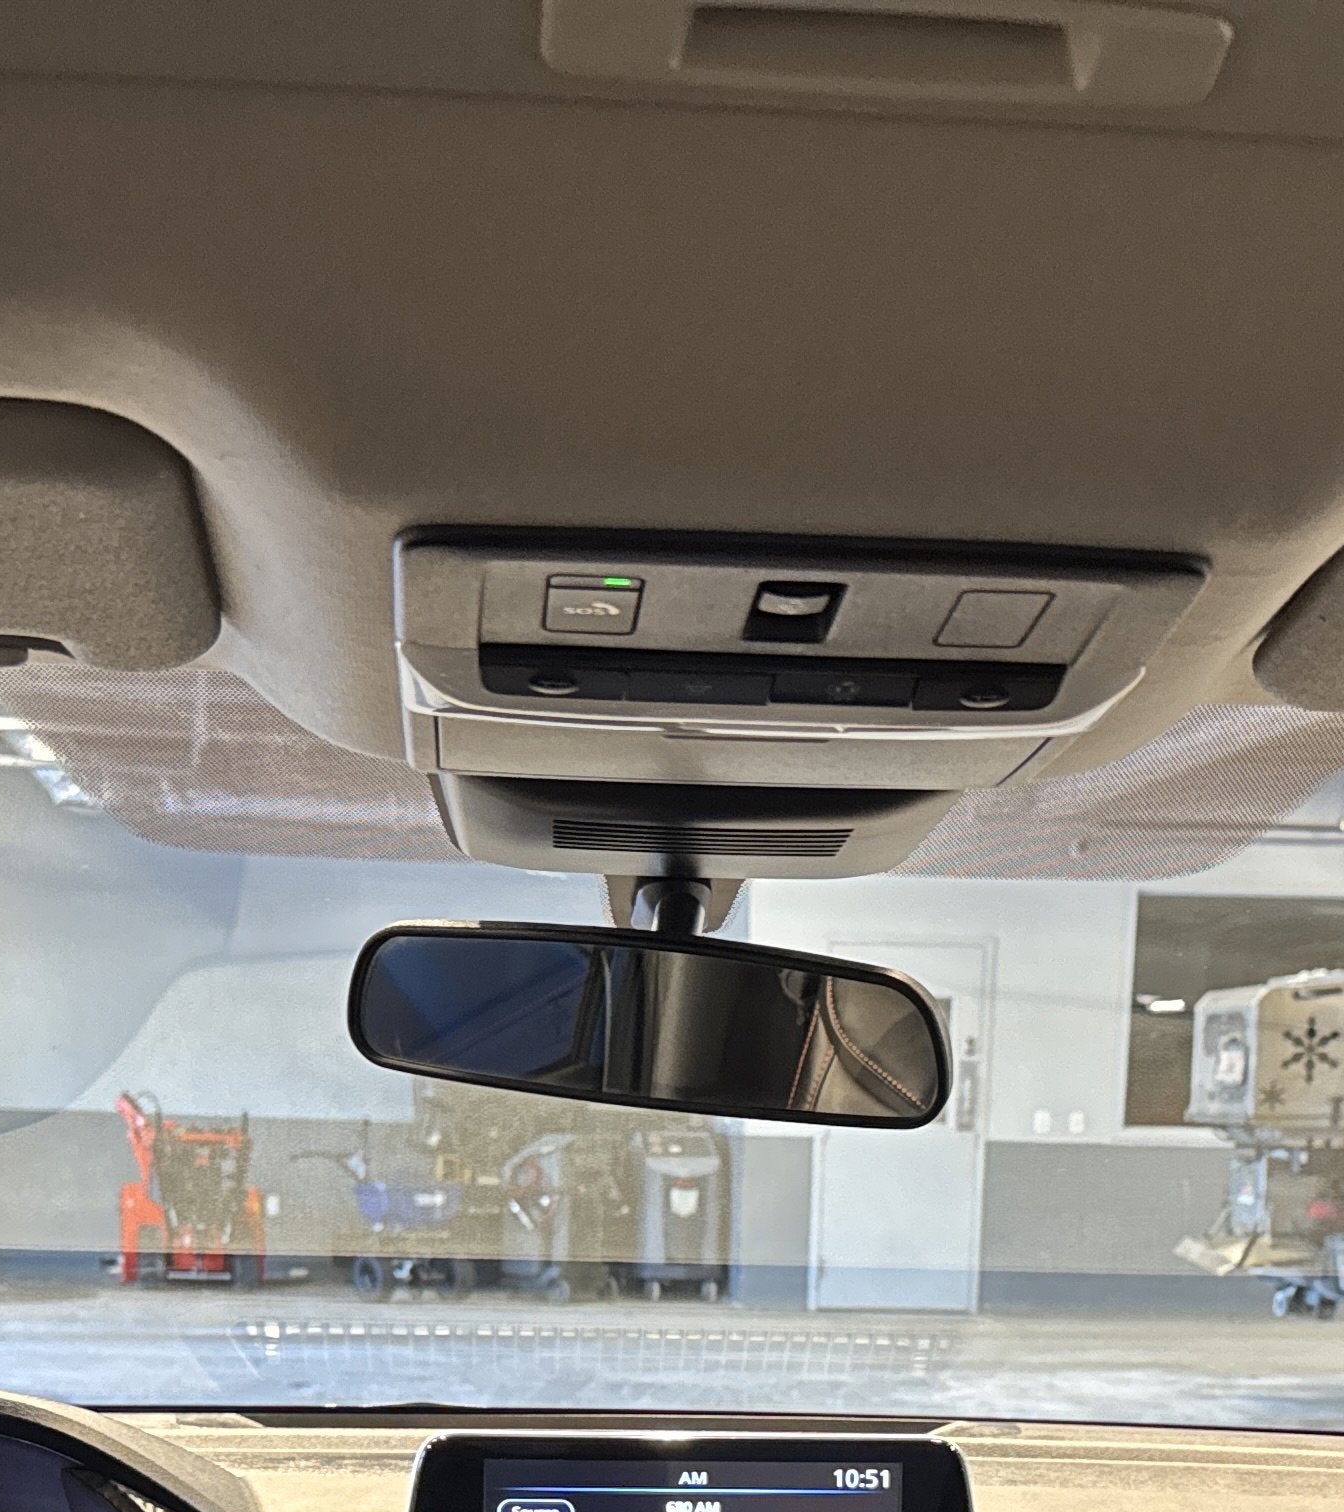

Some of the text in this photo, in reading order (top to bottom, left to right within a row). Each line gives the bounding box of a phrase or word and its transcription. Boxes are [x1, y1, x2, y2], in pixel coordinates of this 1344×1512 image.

[562, 607, 606, 616] SOS
[677, 1471, 708, 1485] AM
[833, 1468, 891, 1489] 10:51
